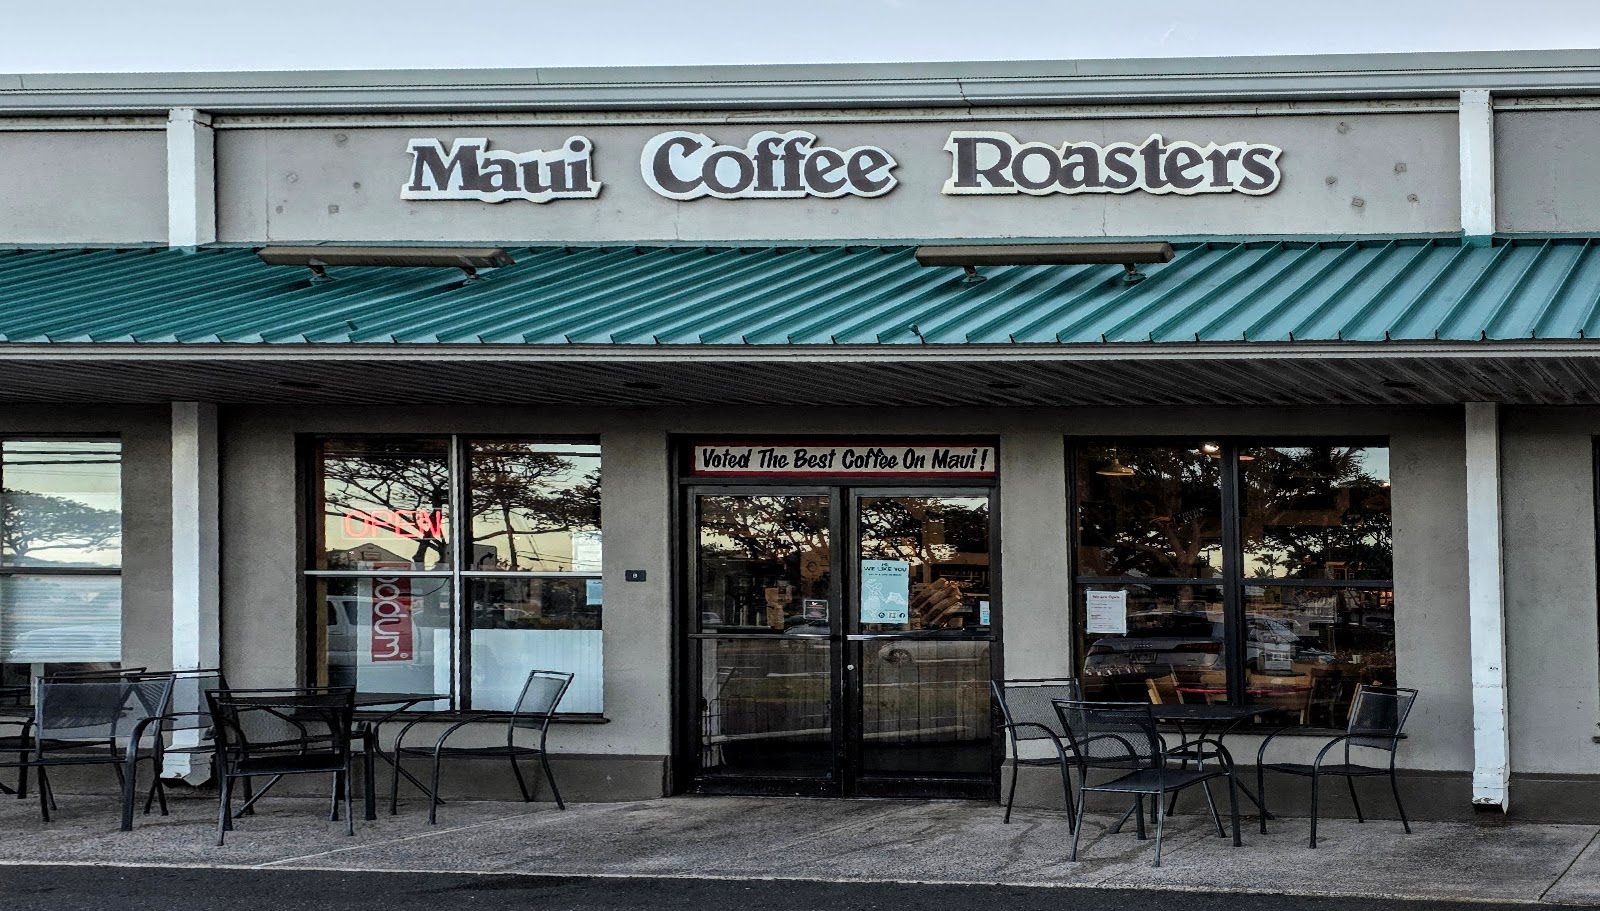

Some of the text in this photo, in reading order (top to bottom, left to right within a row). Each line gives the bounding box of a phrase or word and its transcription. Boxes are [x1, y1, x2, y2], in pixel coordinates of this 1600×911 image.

[407, 135, 1277, 195] Maui Coffee Roasters
[702, 447, 752, 469] Voted
[757, 448, 789, 469] The
[793, 448, 837, 469] Best
[841, 447, 899, 470] Coffee
[902, 448, 926, 469] On
[343, 509, 443, 538] OPEN
